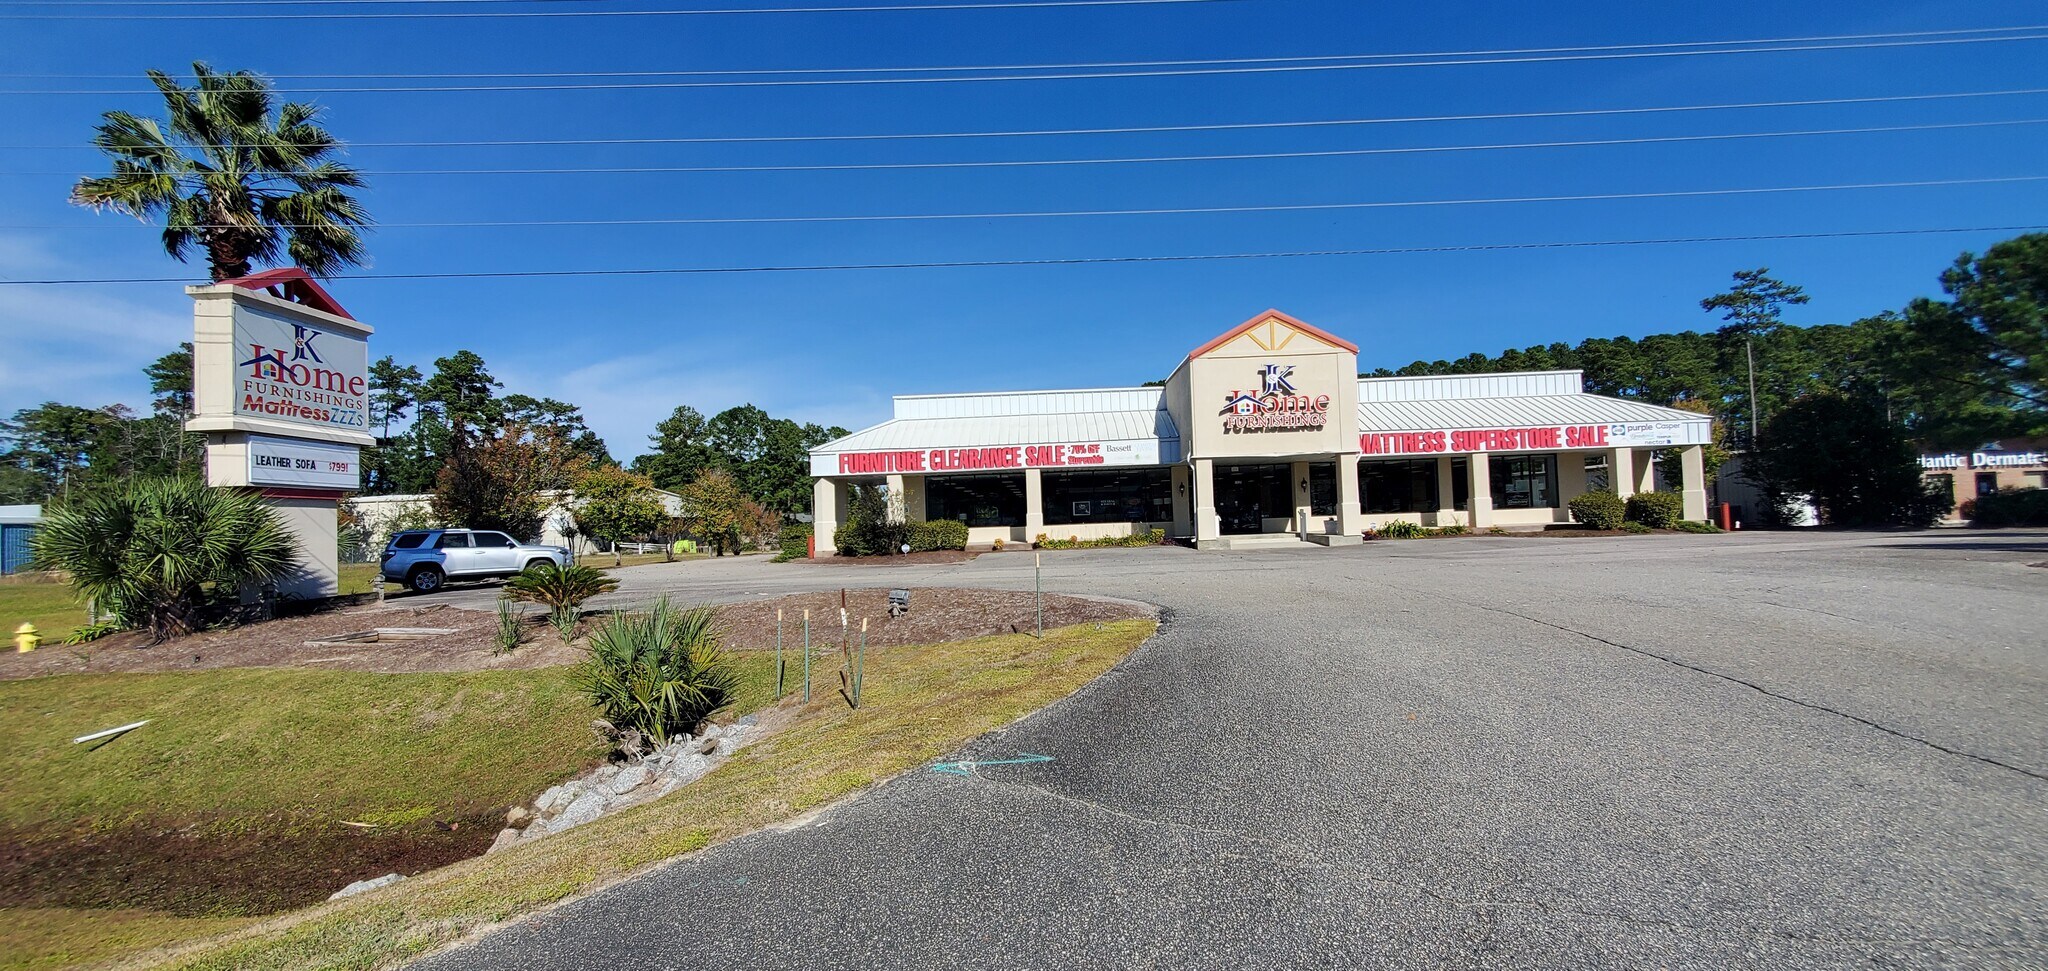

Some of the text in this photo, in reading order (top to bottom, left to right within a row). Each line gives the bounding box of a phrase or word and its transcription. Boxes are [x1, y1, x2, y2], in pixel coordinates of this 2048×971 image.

[249, 343, 365, 397] Home
[243, 380, 363, 410] FURNISHINGS
[1231, 389, 1330, 415] Home
[1227, 412, 1327, 428] FURNISHINGS
[1627, 423, 1653, 432] purple
[1655, 422, 1680, 431] Casper
[1106, 444, 1132, 452] Bassett
[1359, 430, 1446, 454] MATTRESS
[1451, 427, 1561, 451] SUPERSTORE
[1566, 425, 1609, 447] SALE
[255, 454, 291, 468] LEATHER
[295, 458, 317, 471] SOFA
[839, 445, 1066, 473] FURNITURE CLEARANCE SALE
